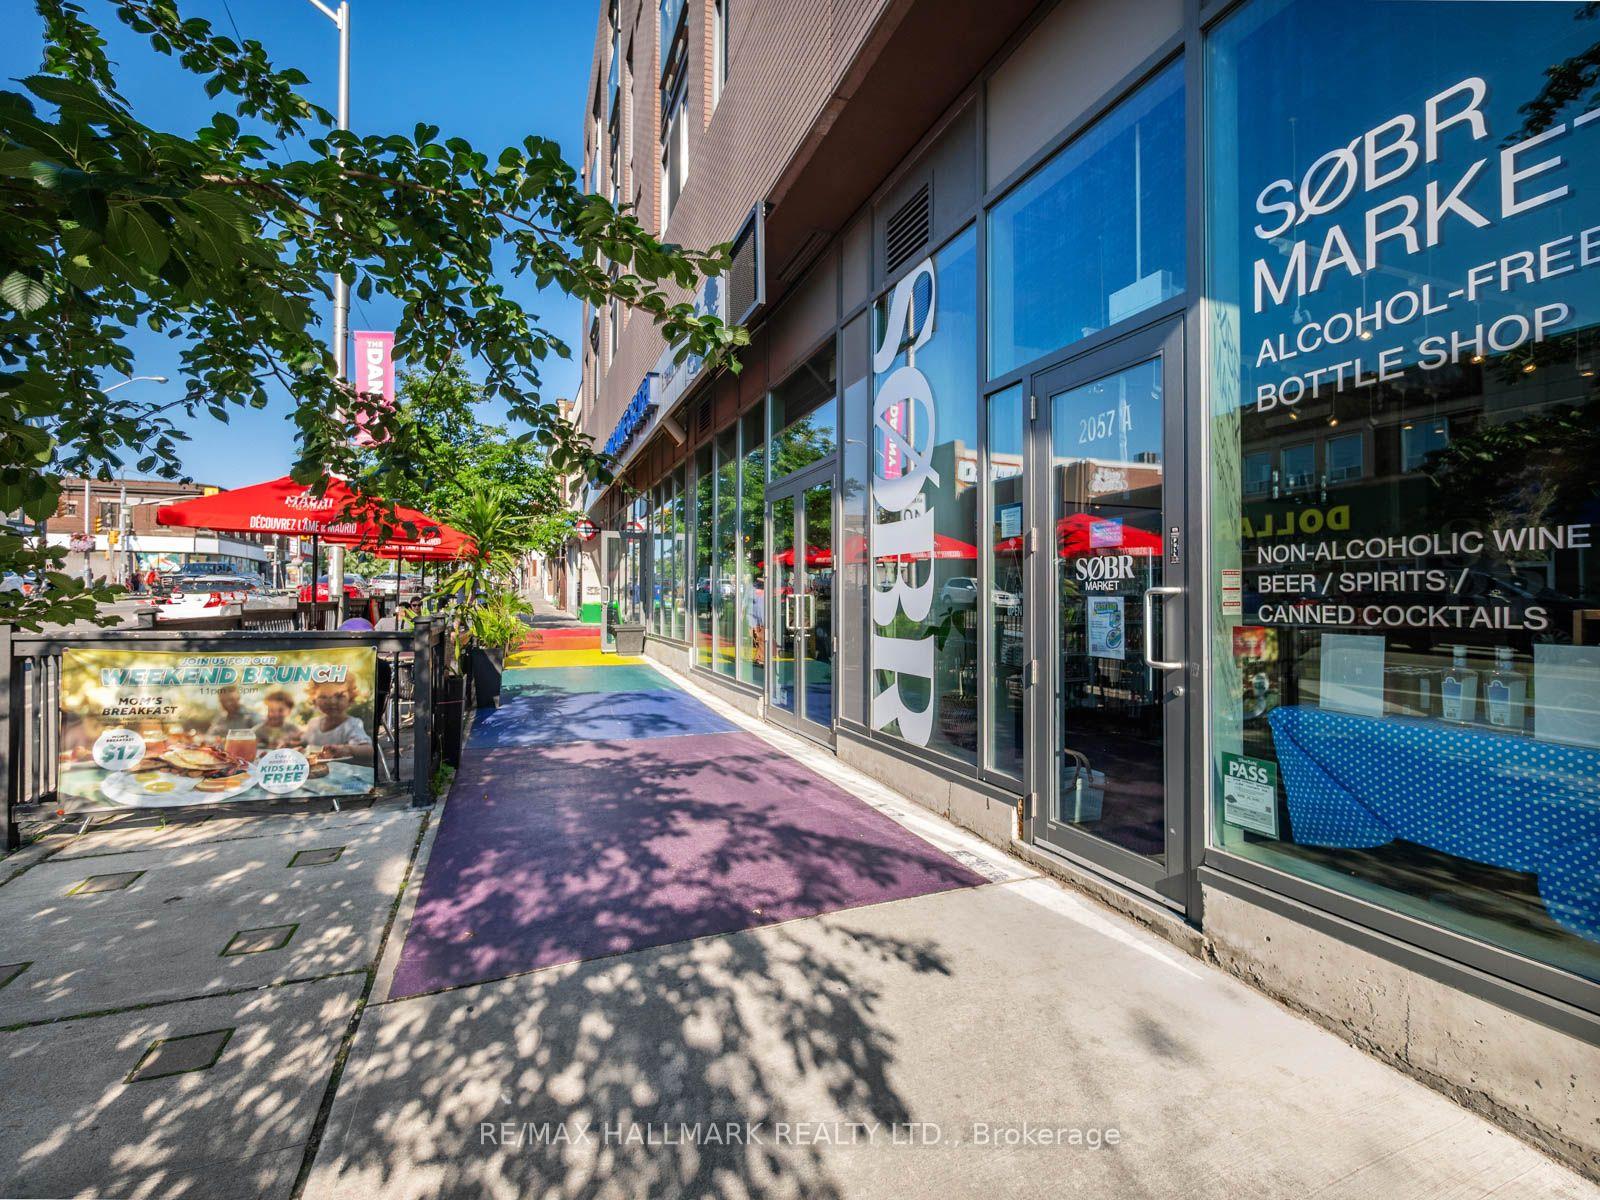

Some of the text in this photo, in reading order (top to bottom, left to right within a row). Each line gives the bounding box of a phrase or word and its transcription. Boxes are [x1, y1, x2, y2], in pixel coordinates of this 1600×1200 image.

[1254, 77, 1488, 239] SØBR
[367, 341, 384, 349] THE
[1257, 303, 1569, 413] BOTTLE SHOP
[1079, 404, 1133, 444] 2057 A
[250, 515, 296, 530] DÉCOUVREZ
[1258, 524, 1592, 564] NON-ALCOHOLIC WINE
[1076, 555, 1135, 581] SØBR
[1085, 580, 1120, 591] MARKET
[1258, 574, 1316, 593] BEER
[1339, 569, 1446, 592] SPIRITS
[1258, 605, 1548, 631] CANNED COCKTAILS
[182, 656, 277, 665] JOIN US FOR OUR
[101, 664, 348, 686] WEEKEND BRUNCH
[102, 705, 178, 715] BREAKFAST
[118, 697, 163, 705] MOM'S
[102, 744, 140, 763] $17
[260, 765, 285, 773] KIDS
[263, 772, 304, 784] FREE
[1229, 760, 1268, 784] PASS
